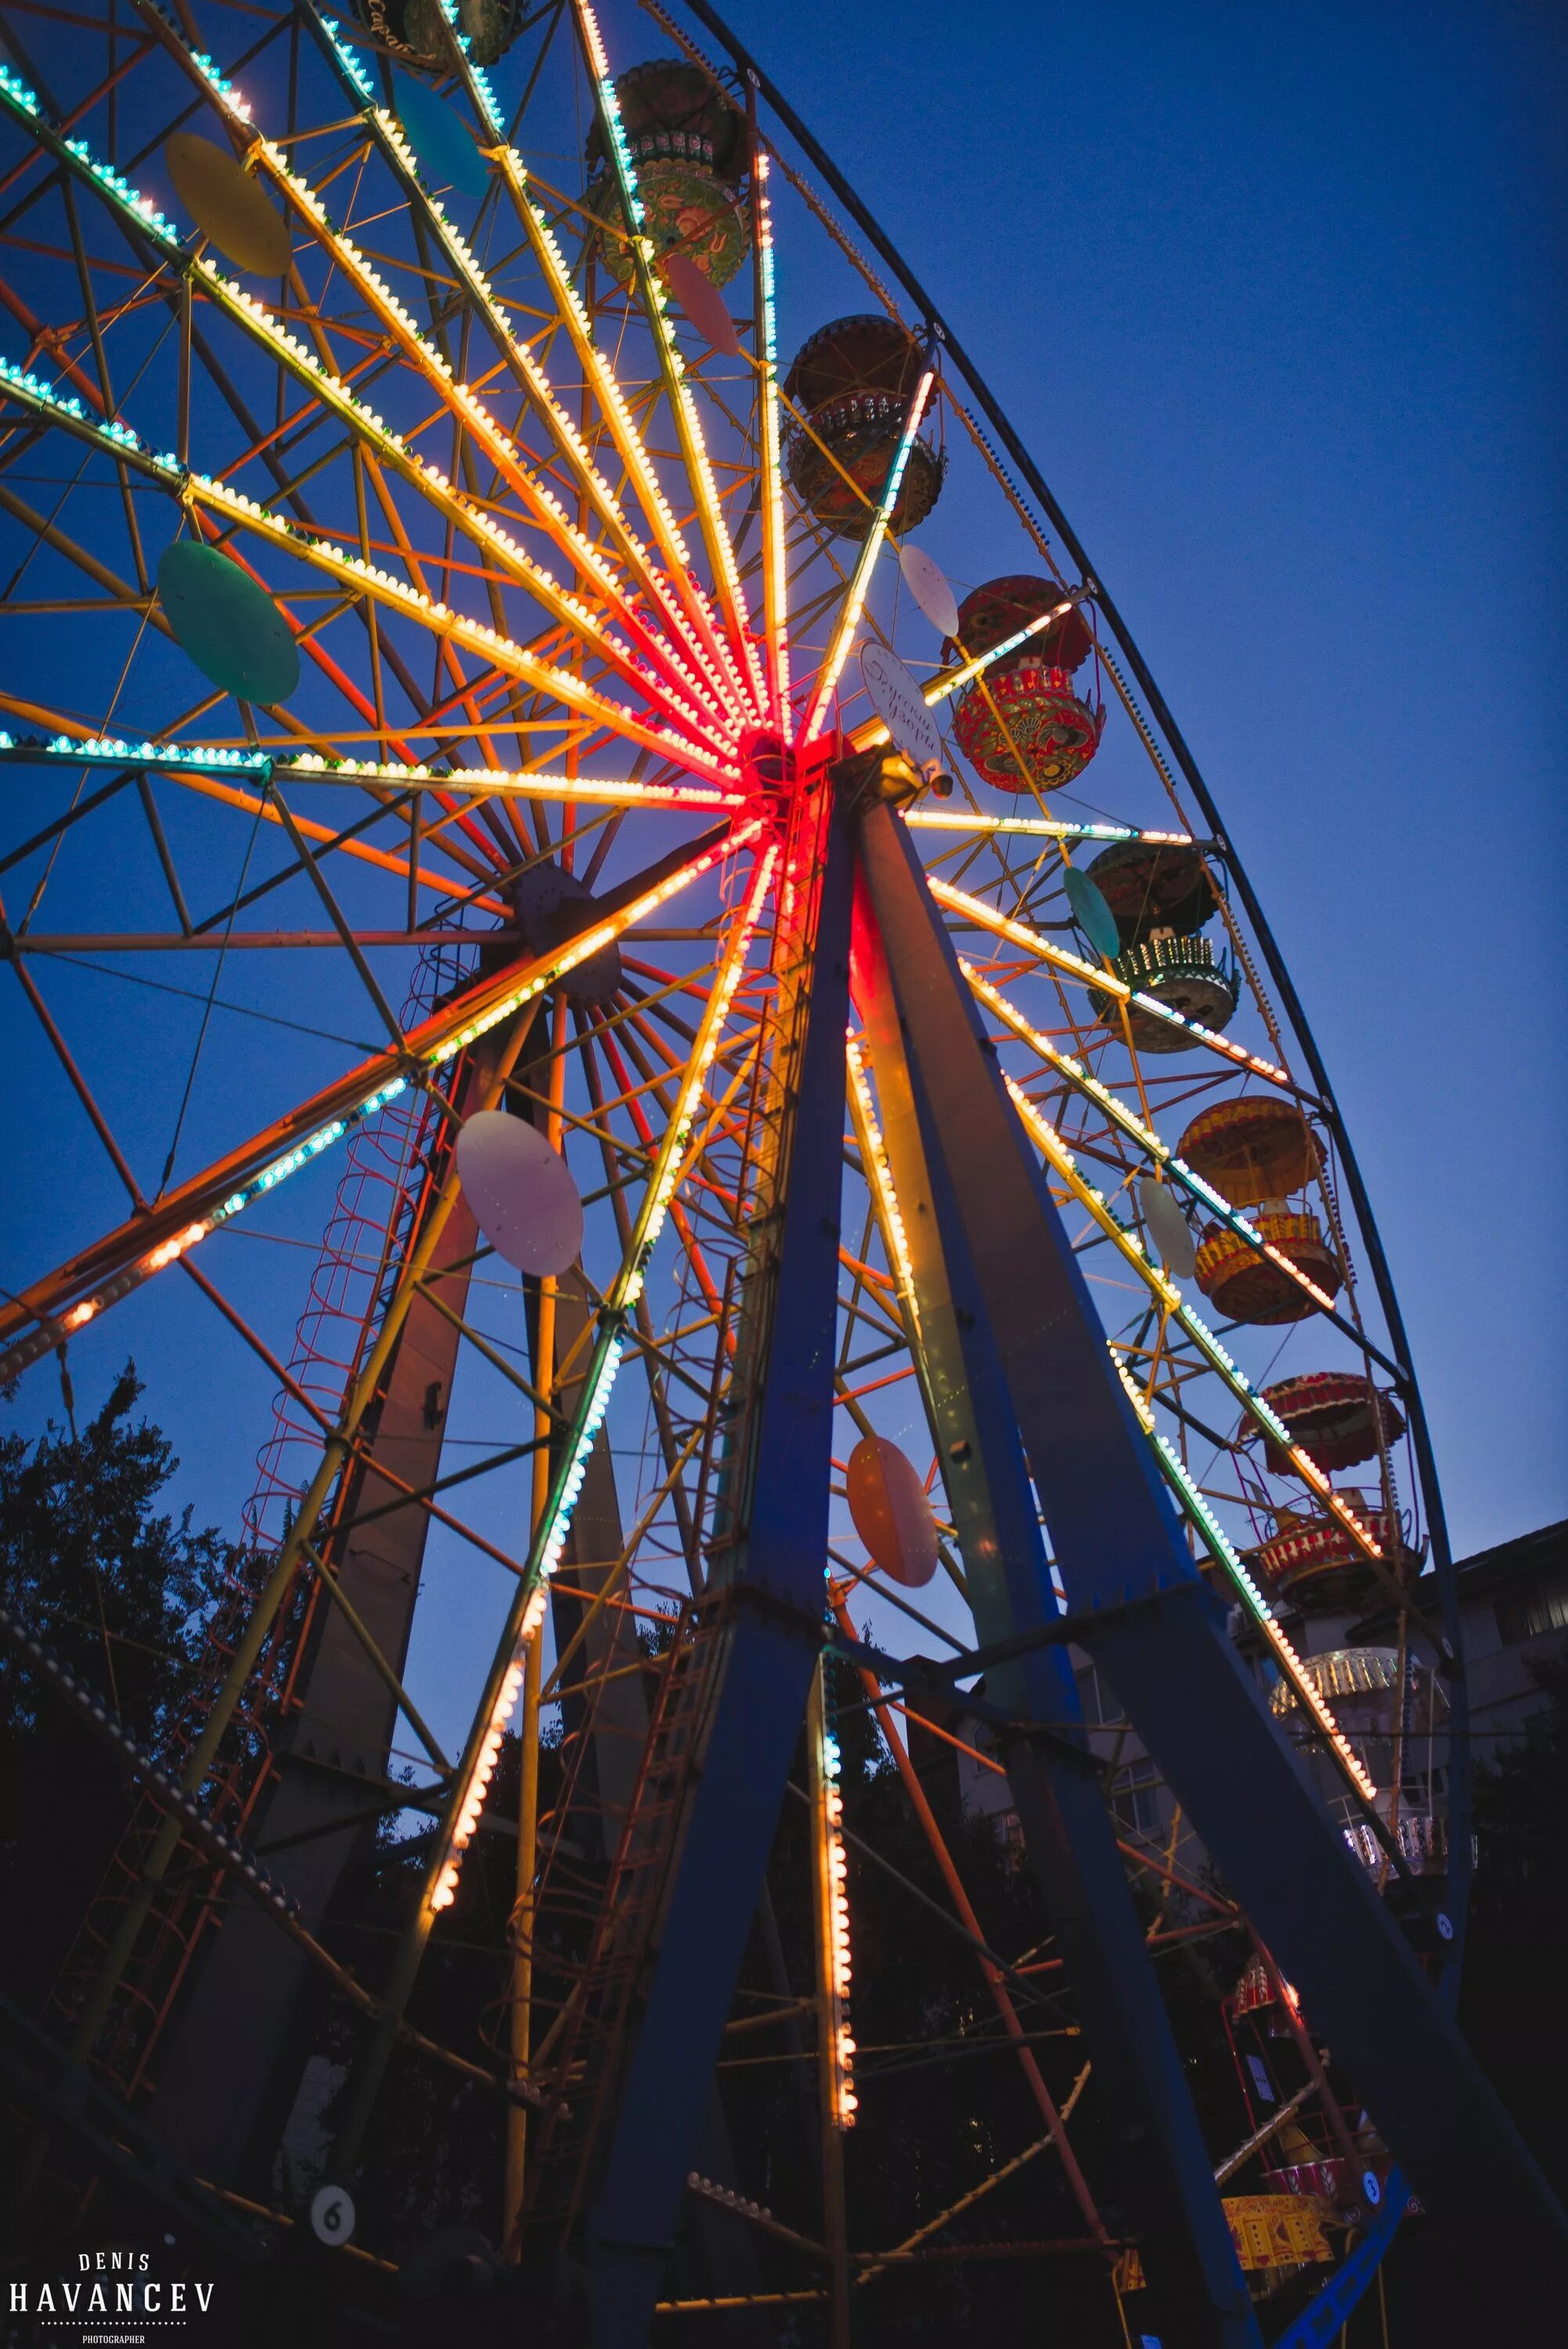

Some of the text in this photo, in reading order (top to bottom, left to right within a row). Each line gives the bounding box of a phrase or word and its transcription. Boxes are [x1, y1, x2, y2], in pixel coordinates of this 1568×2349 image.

[1440, 1920, 1450, 1936] 2
[1367, 2179, 1376, 2197] 3
[323, 2201, 342, 2232] 6
